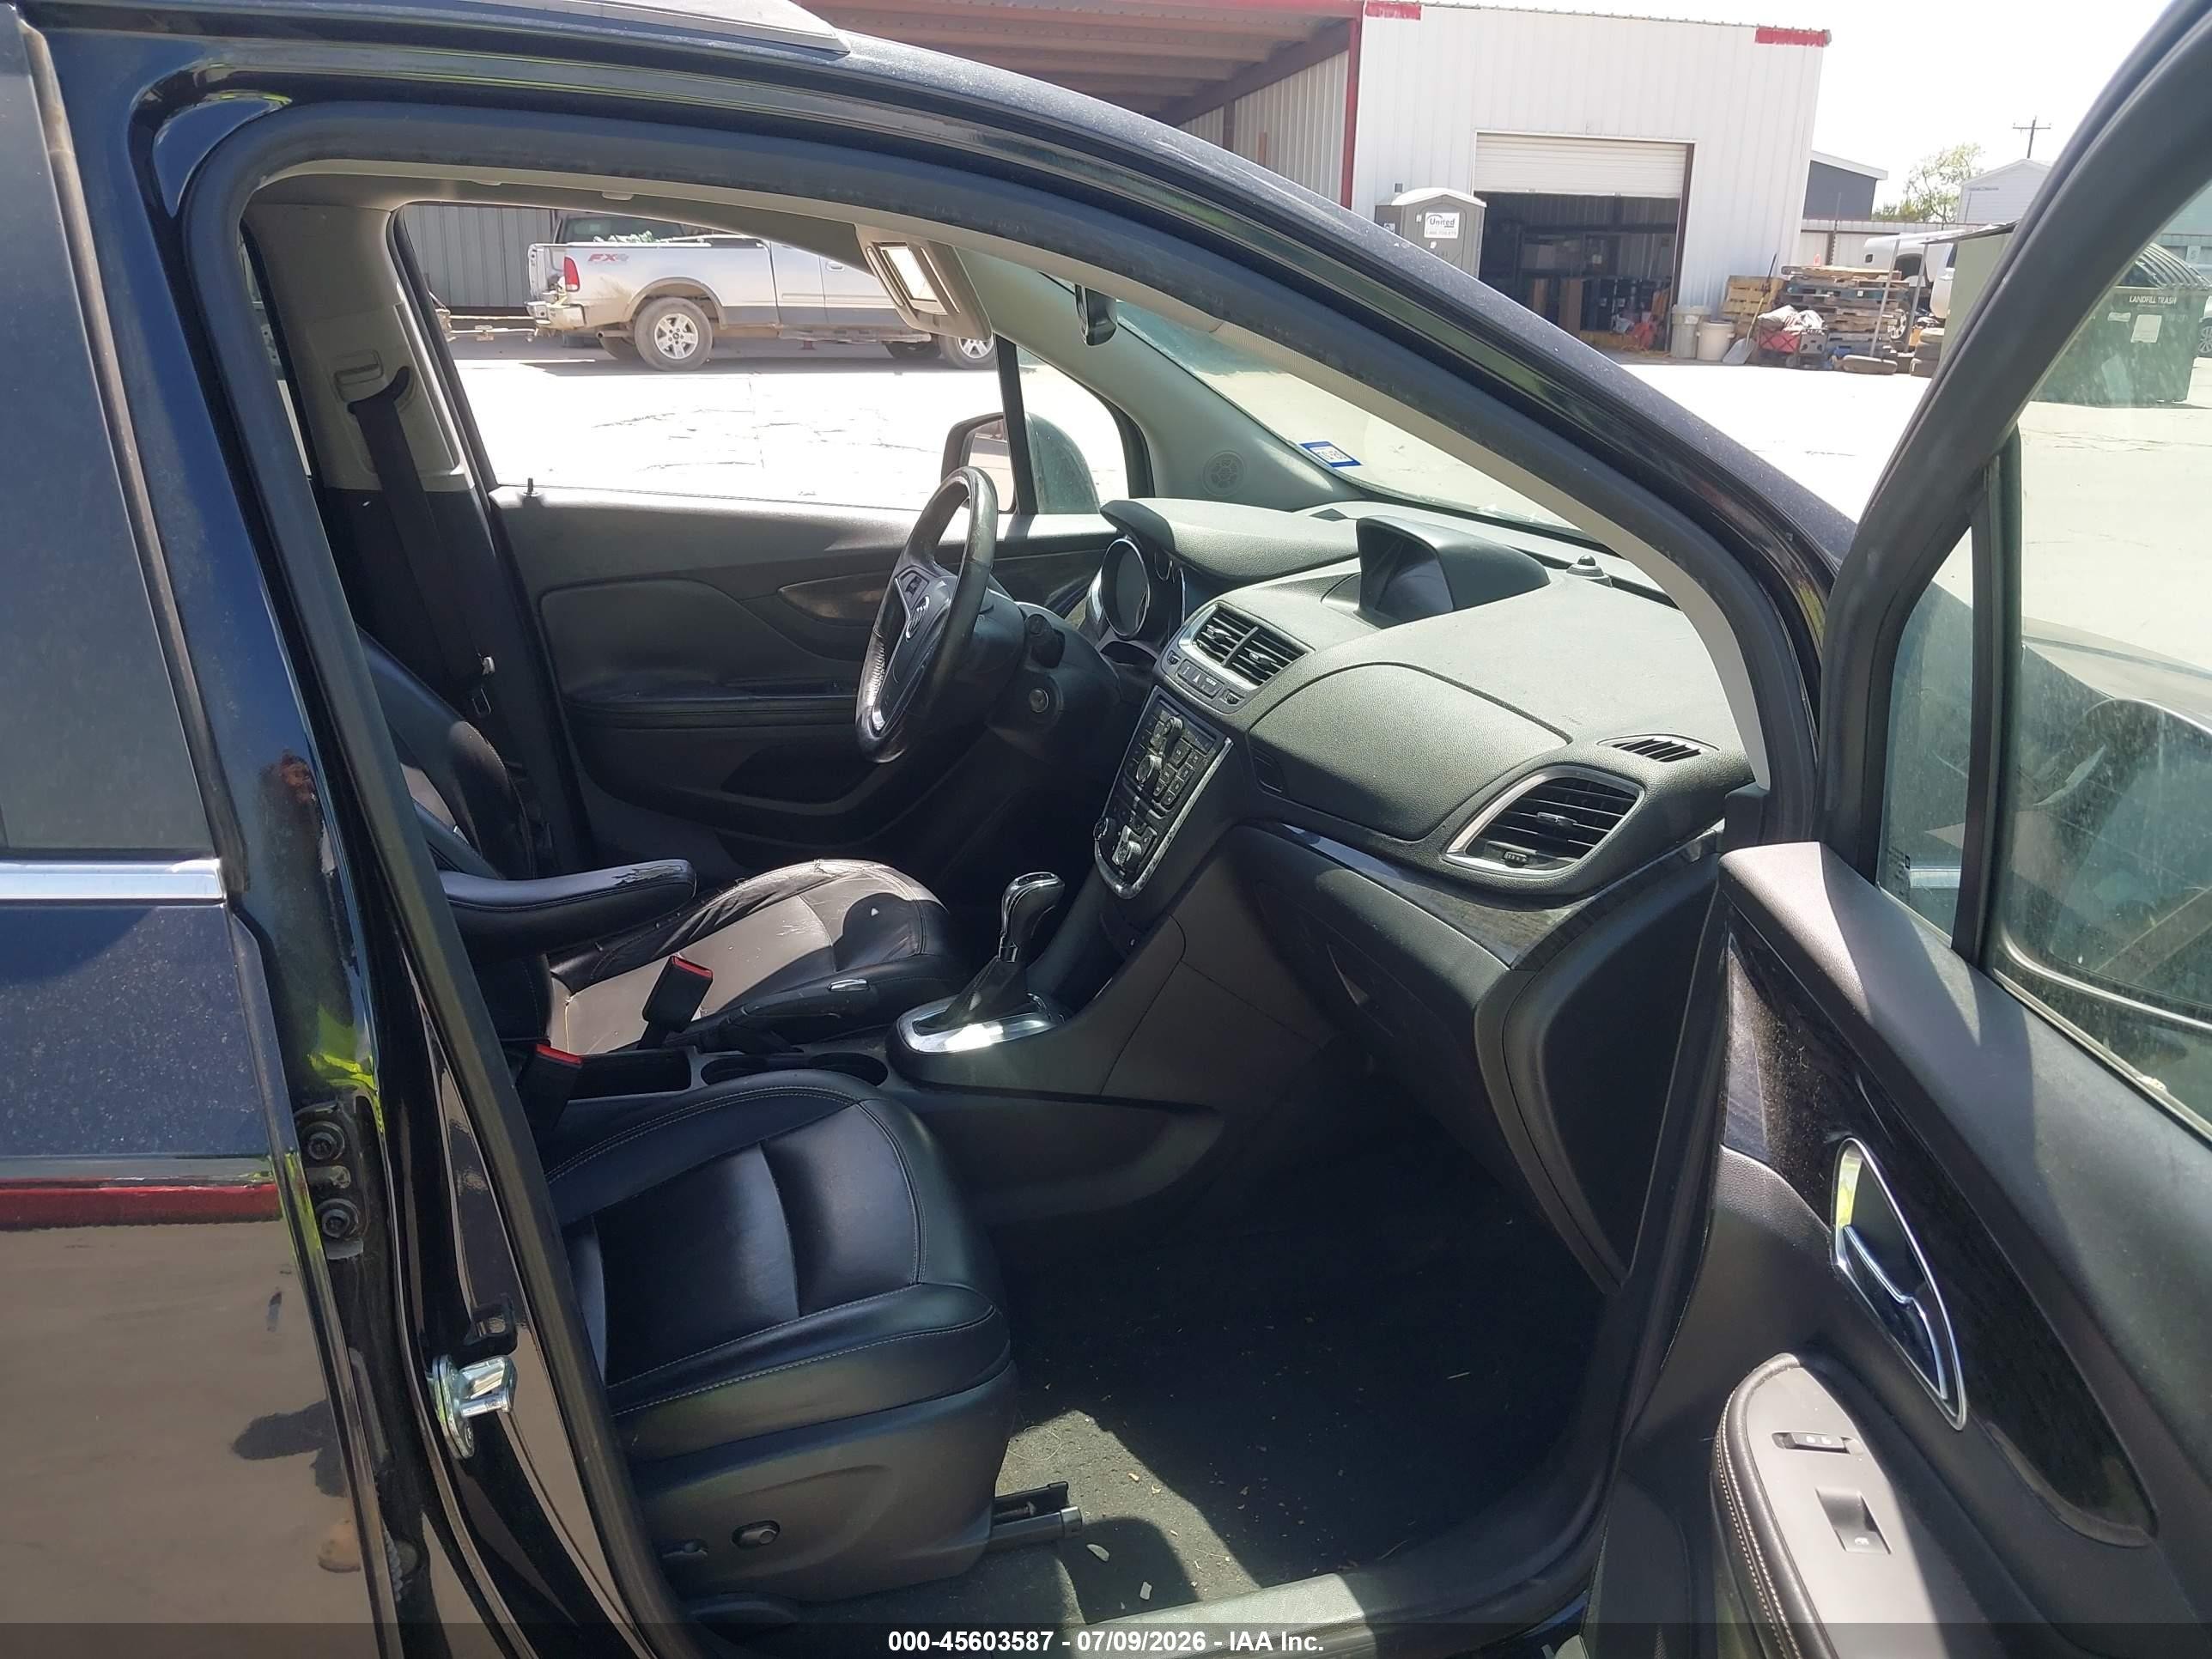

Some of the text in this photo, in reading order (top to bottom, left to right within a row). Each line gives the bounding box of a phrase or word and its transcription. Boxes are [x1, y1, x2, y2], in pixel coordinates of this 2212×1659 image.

[1430, 217, 1455, 226] United
[2129, 295, 2177, 305] LANDFILL TRASH
